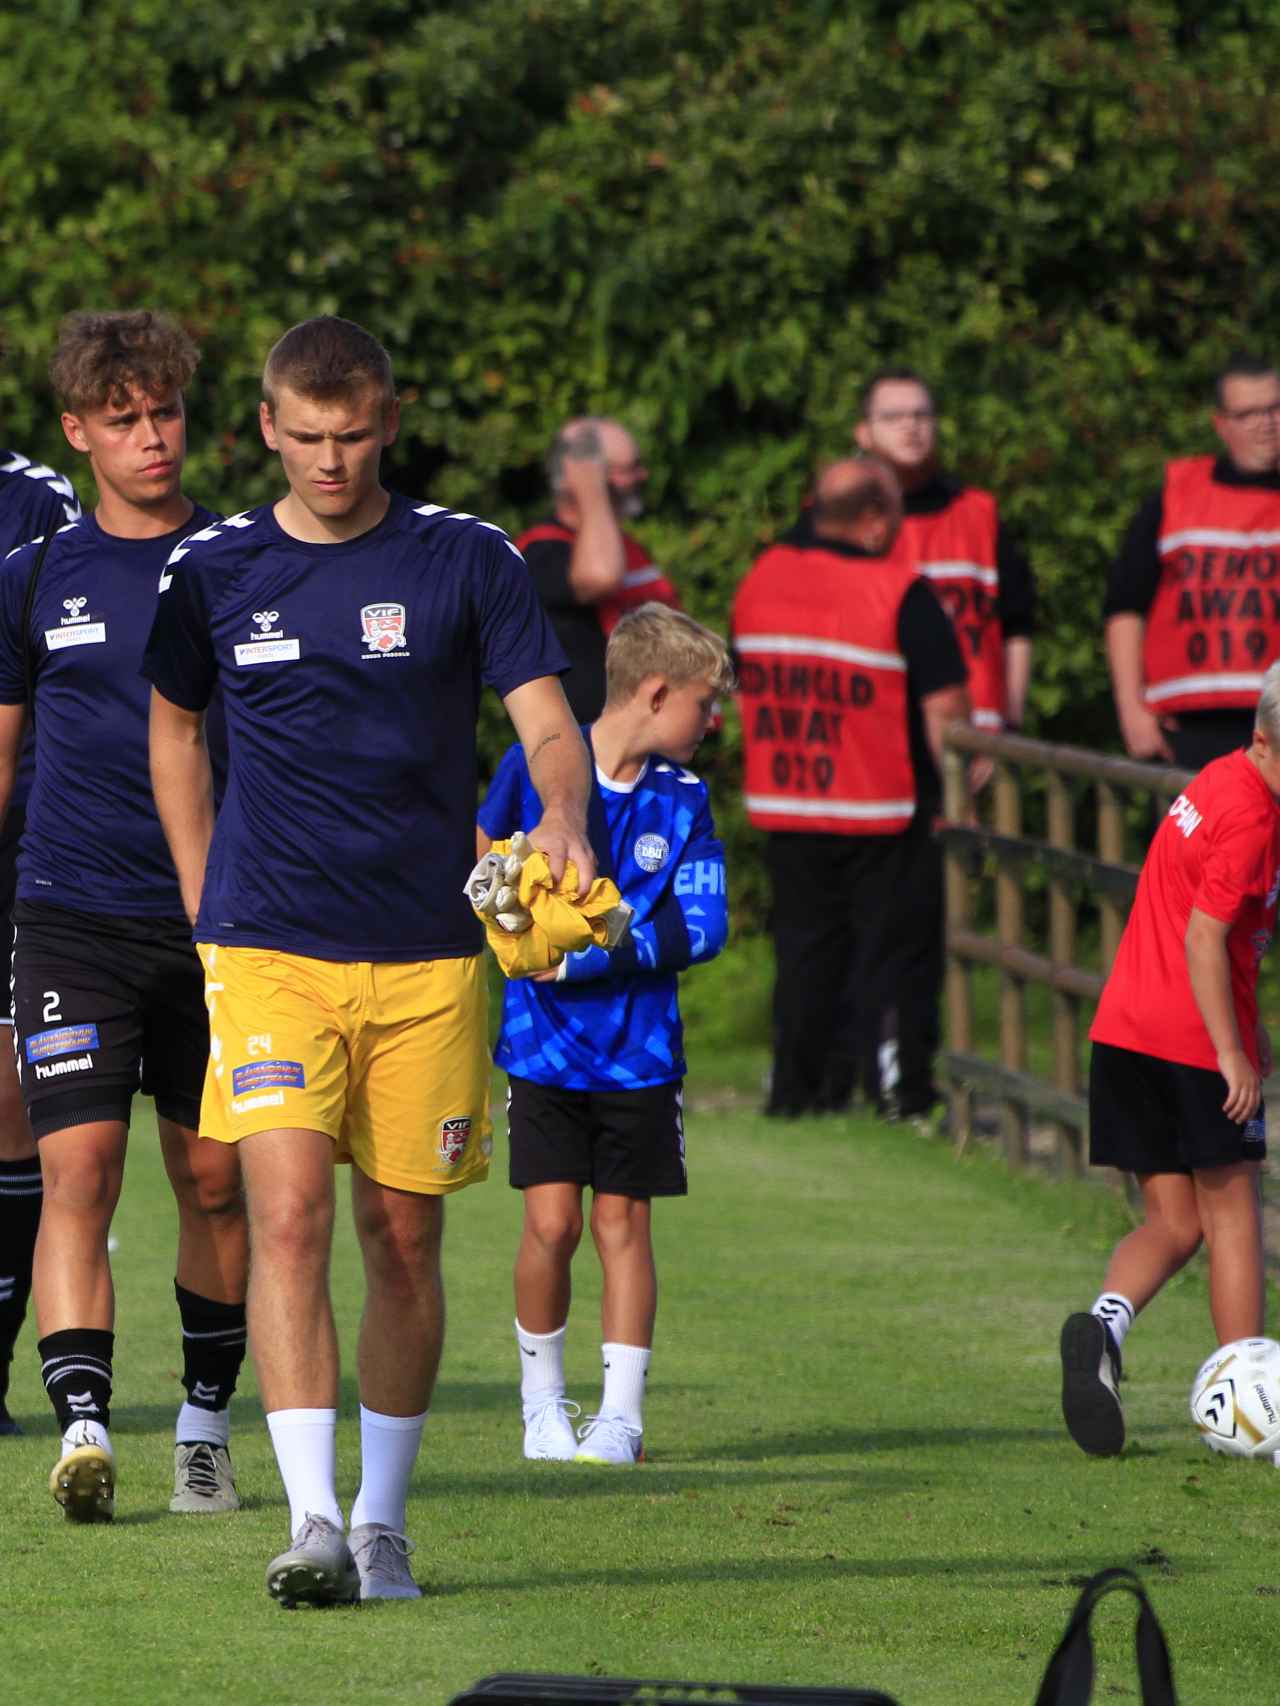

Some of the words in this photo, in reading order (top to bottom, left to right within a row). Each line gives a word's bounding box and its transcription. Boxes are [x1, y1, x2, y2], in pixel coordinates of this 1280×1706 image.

[367, 608, 400, 618] VIF
[42, 990, 63, 1023] 2
[35, 1053, 94, 1080] hummel
